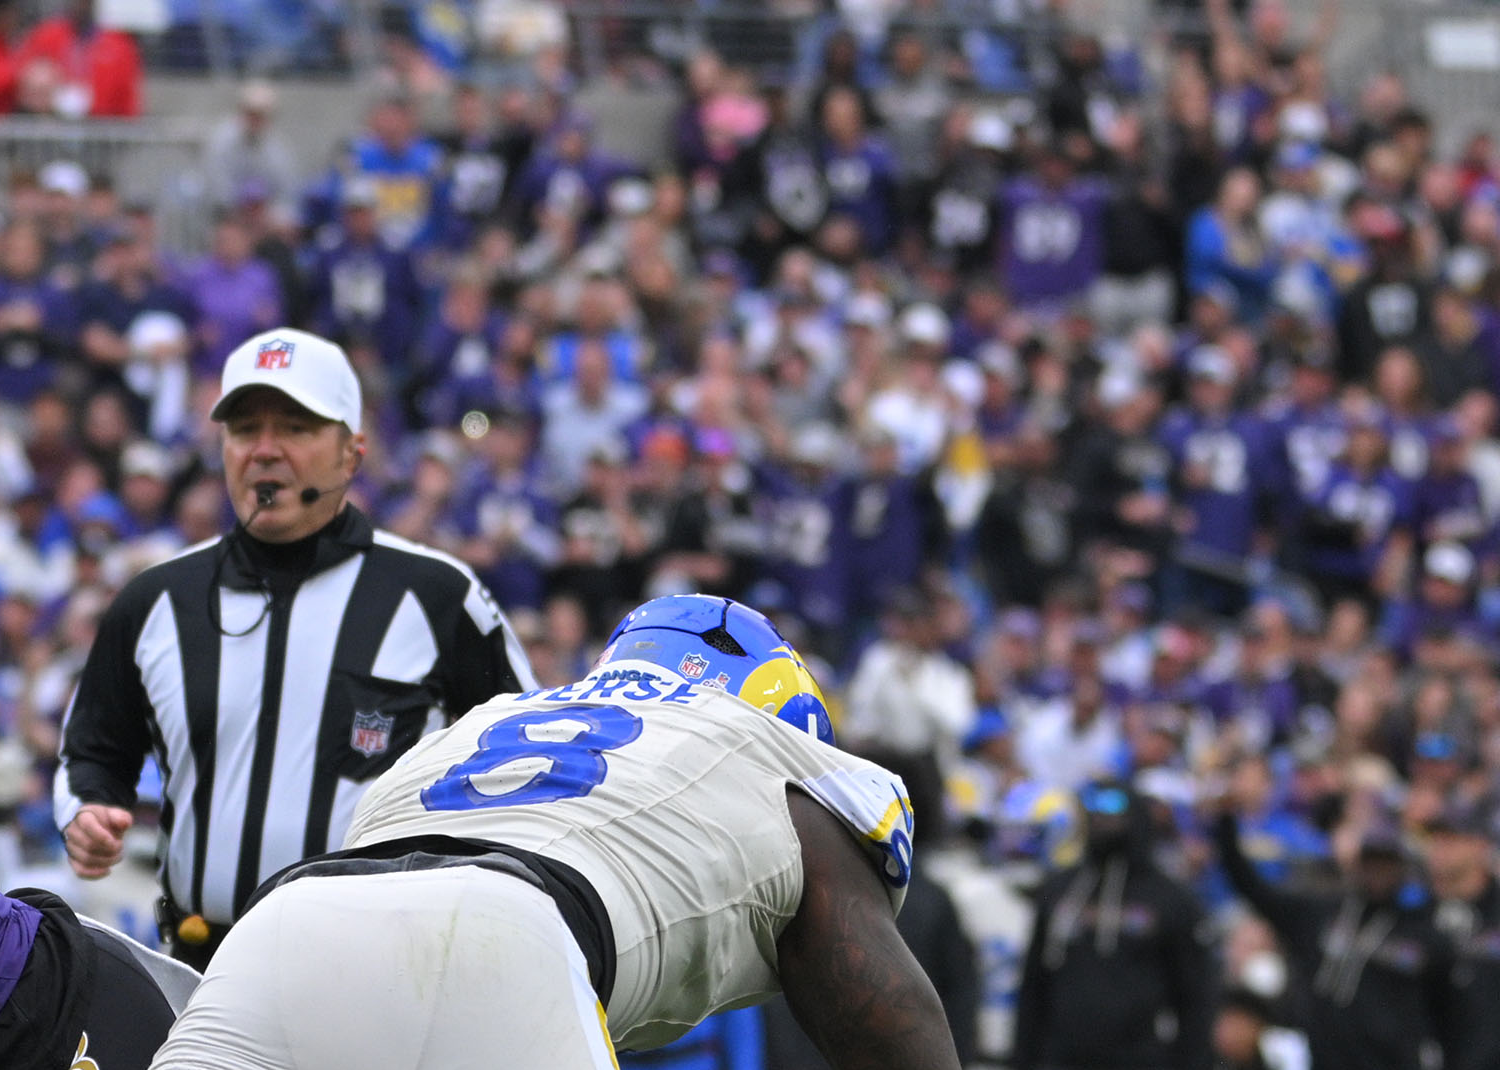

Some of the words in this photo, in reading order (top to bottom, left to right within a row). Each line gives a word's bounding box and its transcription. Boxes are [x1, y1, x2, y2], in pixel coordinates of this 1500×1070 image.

[257, 351, 290, 370] NFL
[681, 662, 701, 678] NFL
[355, 729, 388, 752] NFL
[420, 704, 643, 812] 8
